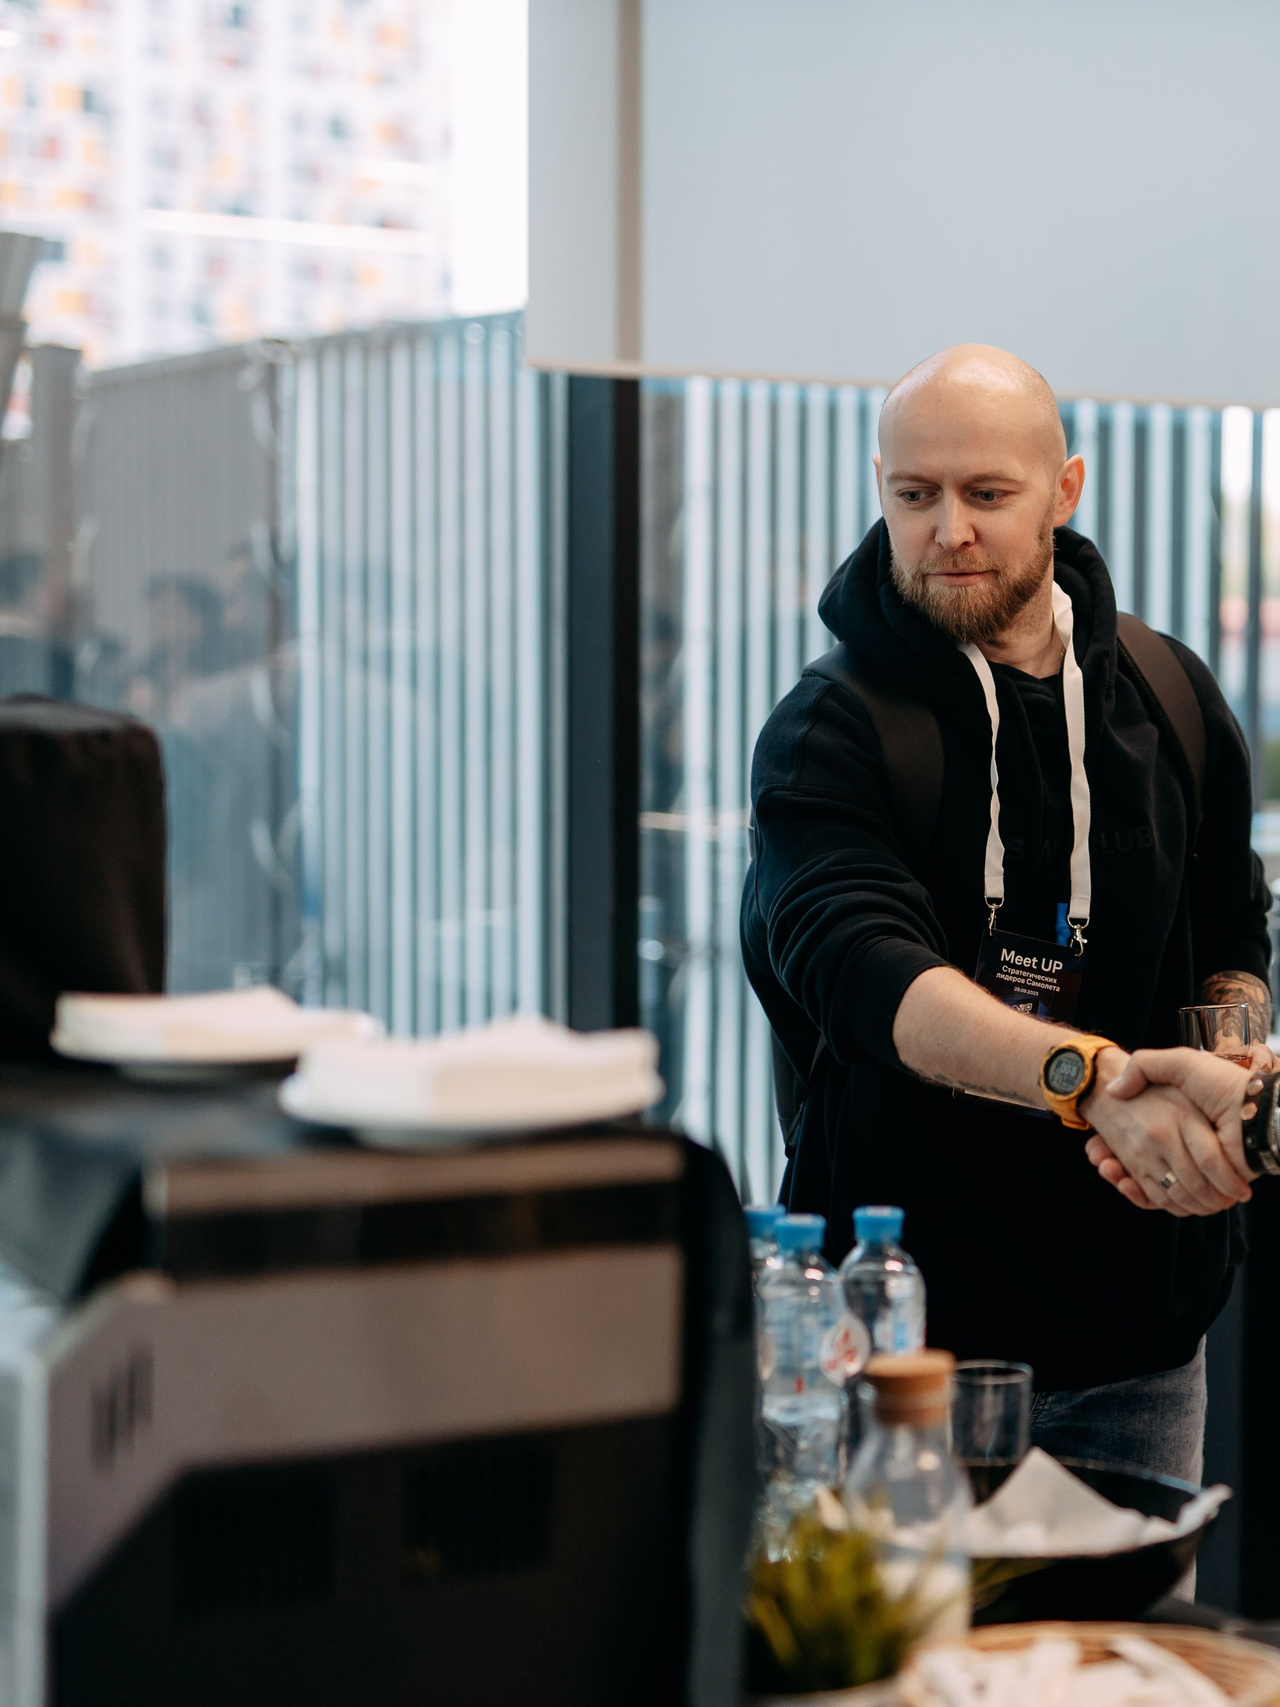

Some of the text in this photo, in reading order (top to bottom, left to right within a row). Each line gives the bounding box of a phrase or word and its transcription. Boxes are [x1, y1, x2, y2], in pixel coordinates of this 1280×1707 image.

[1000, 948, 1063, 974] Meet UP
[996, 972, 1060, 992] лидеров Самолета
[1002, 965, 1058, 984] Стратегических
